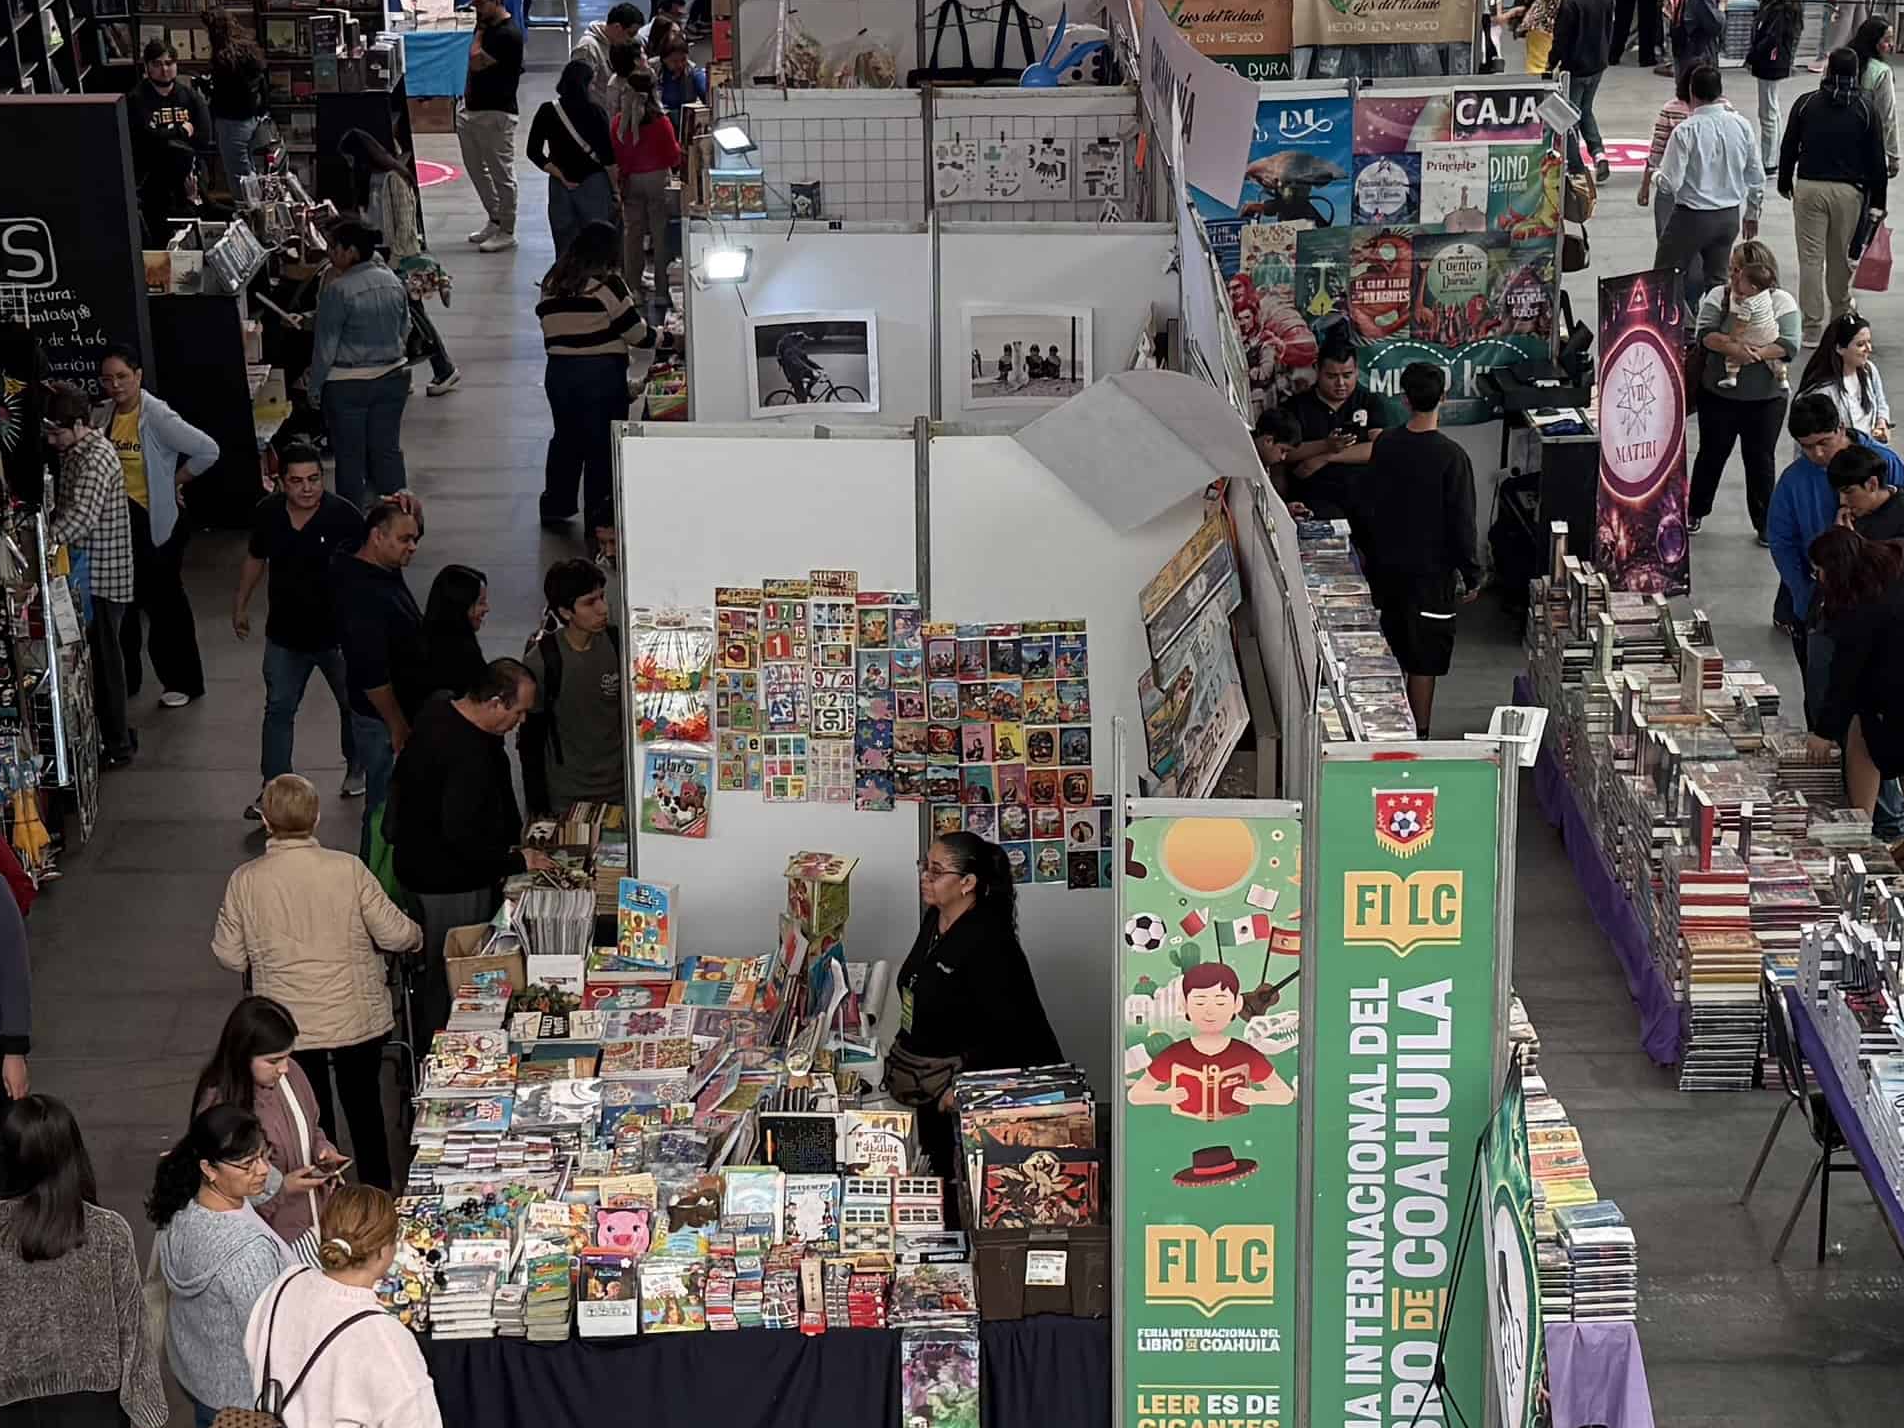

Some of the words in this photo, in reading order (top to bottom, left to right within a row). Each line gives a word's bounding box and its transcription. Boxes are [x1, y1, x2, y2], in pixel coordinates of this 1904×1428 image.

[1247, 61, 1289, 76] DURA
[1455, 96, 1540, 126] CAJA
[1490, 155, 1530, 182] DINO
[1347, 977, 1389, 1053] DEL
[1394, 977, 1454, 1278] COAHUILA
[1343, 1062, 1388, 1389] INTERNACIONAL
[1137, 1328, 1168, 1338] FERIA
[1171, 1328, 1257, 1339] INTERNACIONAL
[1260, 1329, 1280, 1339] DEL
[1137, 1339, 1183, 1352] LIBRO
[1200, 1339, 1281, 1352] COAHUILA
[1137, 1394, 1200, 1415] LEER
[1207, 1394, 1239, 1415] ES
[1246, 1394, 1281, 1415] DE
